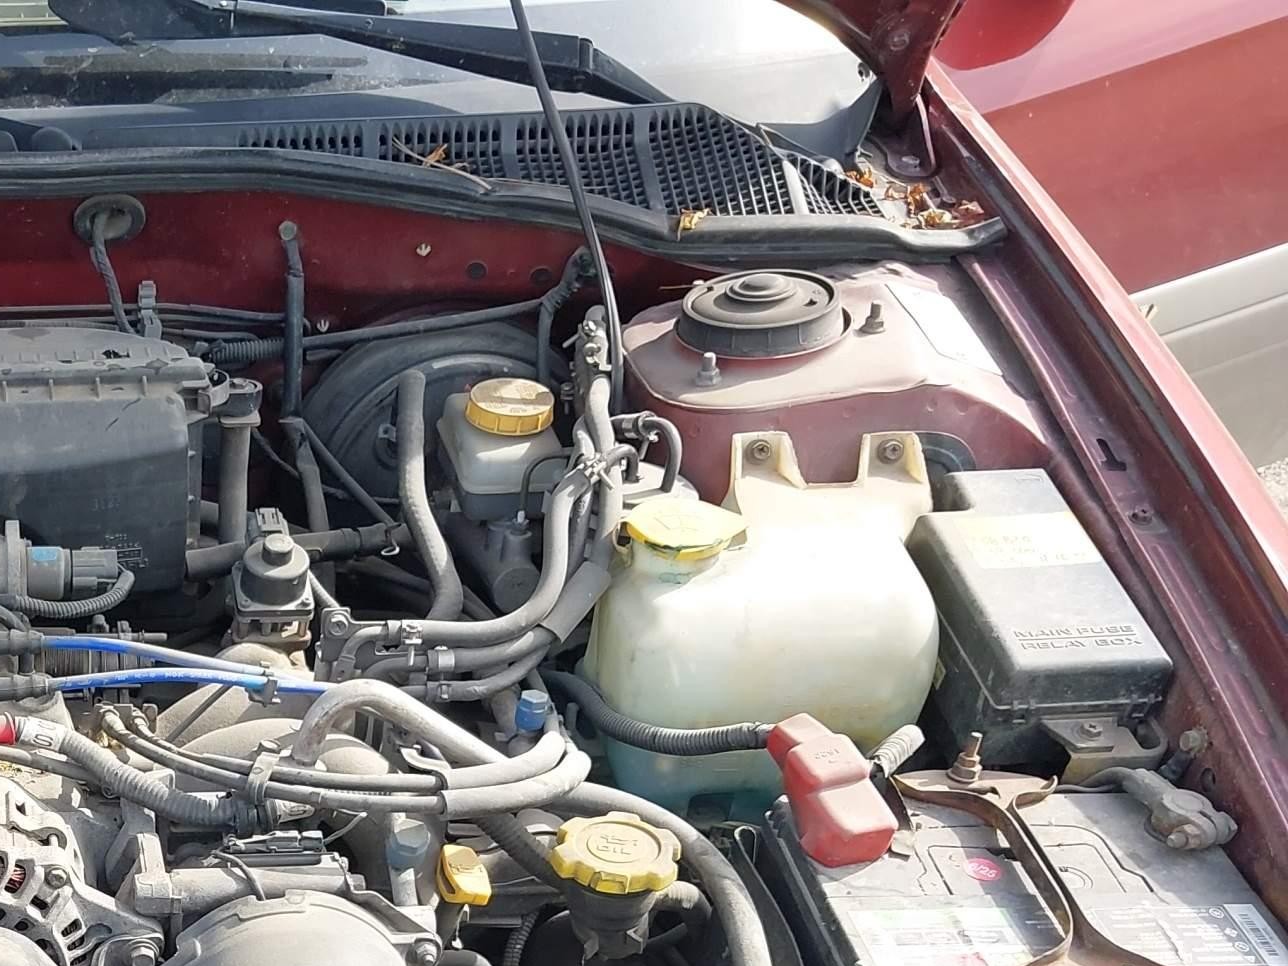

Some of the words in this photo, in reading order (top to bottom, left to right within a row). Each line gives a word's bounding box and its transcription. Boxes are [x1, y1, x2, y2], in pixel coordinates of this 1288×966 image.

[1014, 627, 1072, 638] MAIN
[1076, 624, 1135, 635] FUSE
[1020, 640, 1086, 650] RELAY
[1094, 638, 1143, 648] BOX
